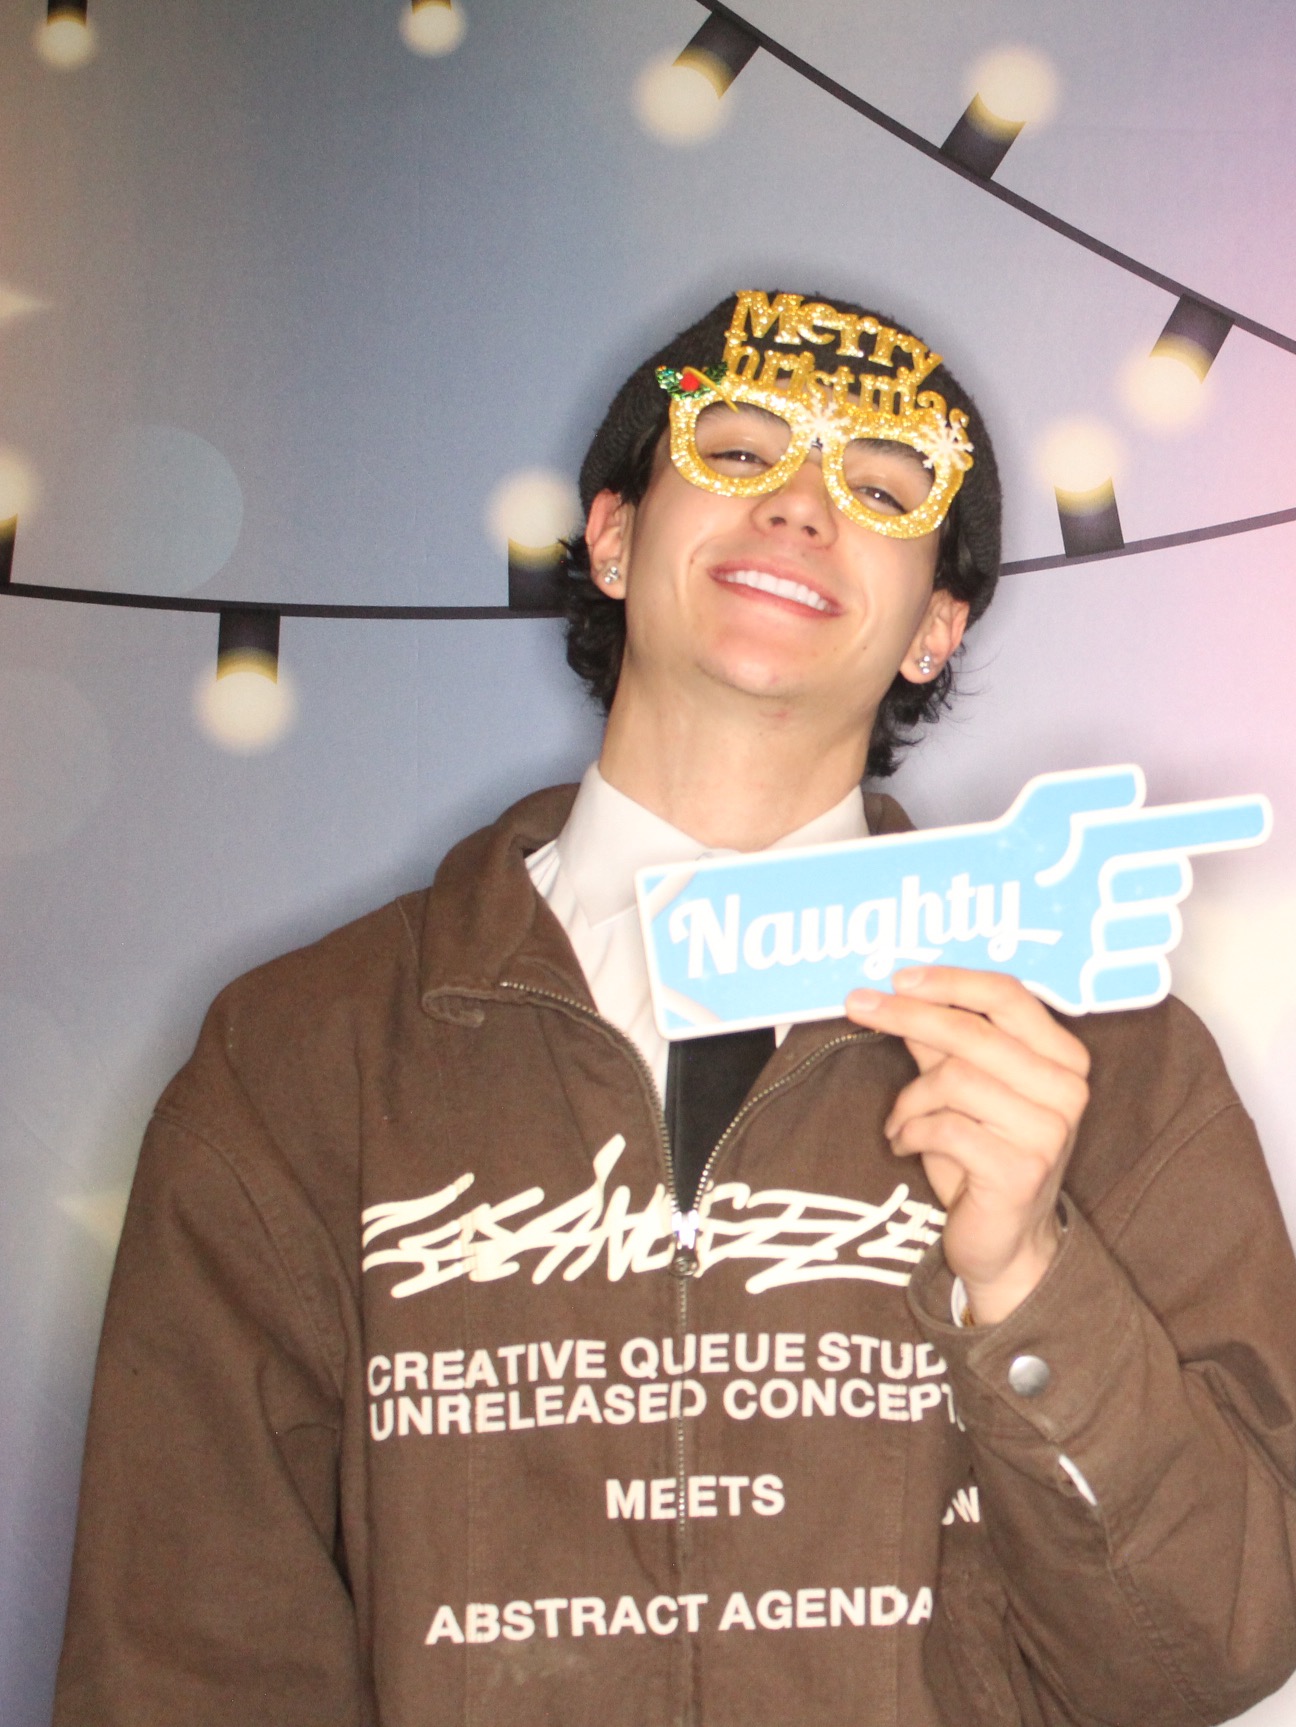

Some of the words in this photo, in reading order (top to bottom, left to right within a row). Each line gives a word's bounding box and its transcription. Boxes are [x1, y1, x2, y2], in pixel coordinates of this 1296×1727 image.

[724, 290, 943, 384] Merry
[669, 872, 1062, 980] Naughty
[367, 1341, 607, 1397] CREATIVE
[620, 1332, 806, 1380] QUEUE
[369, 1380, 707, 1441] UNRELEASED
[723, 1378, 966, 1432] CONCEPT
[606, 1475, 785, 1520] MEETS
[426, 1593, 709, 1645] ABSTRACT
[718, 1585, 933, 1631] AGENDA
